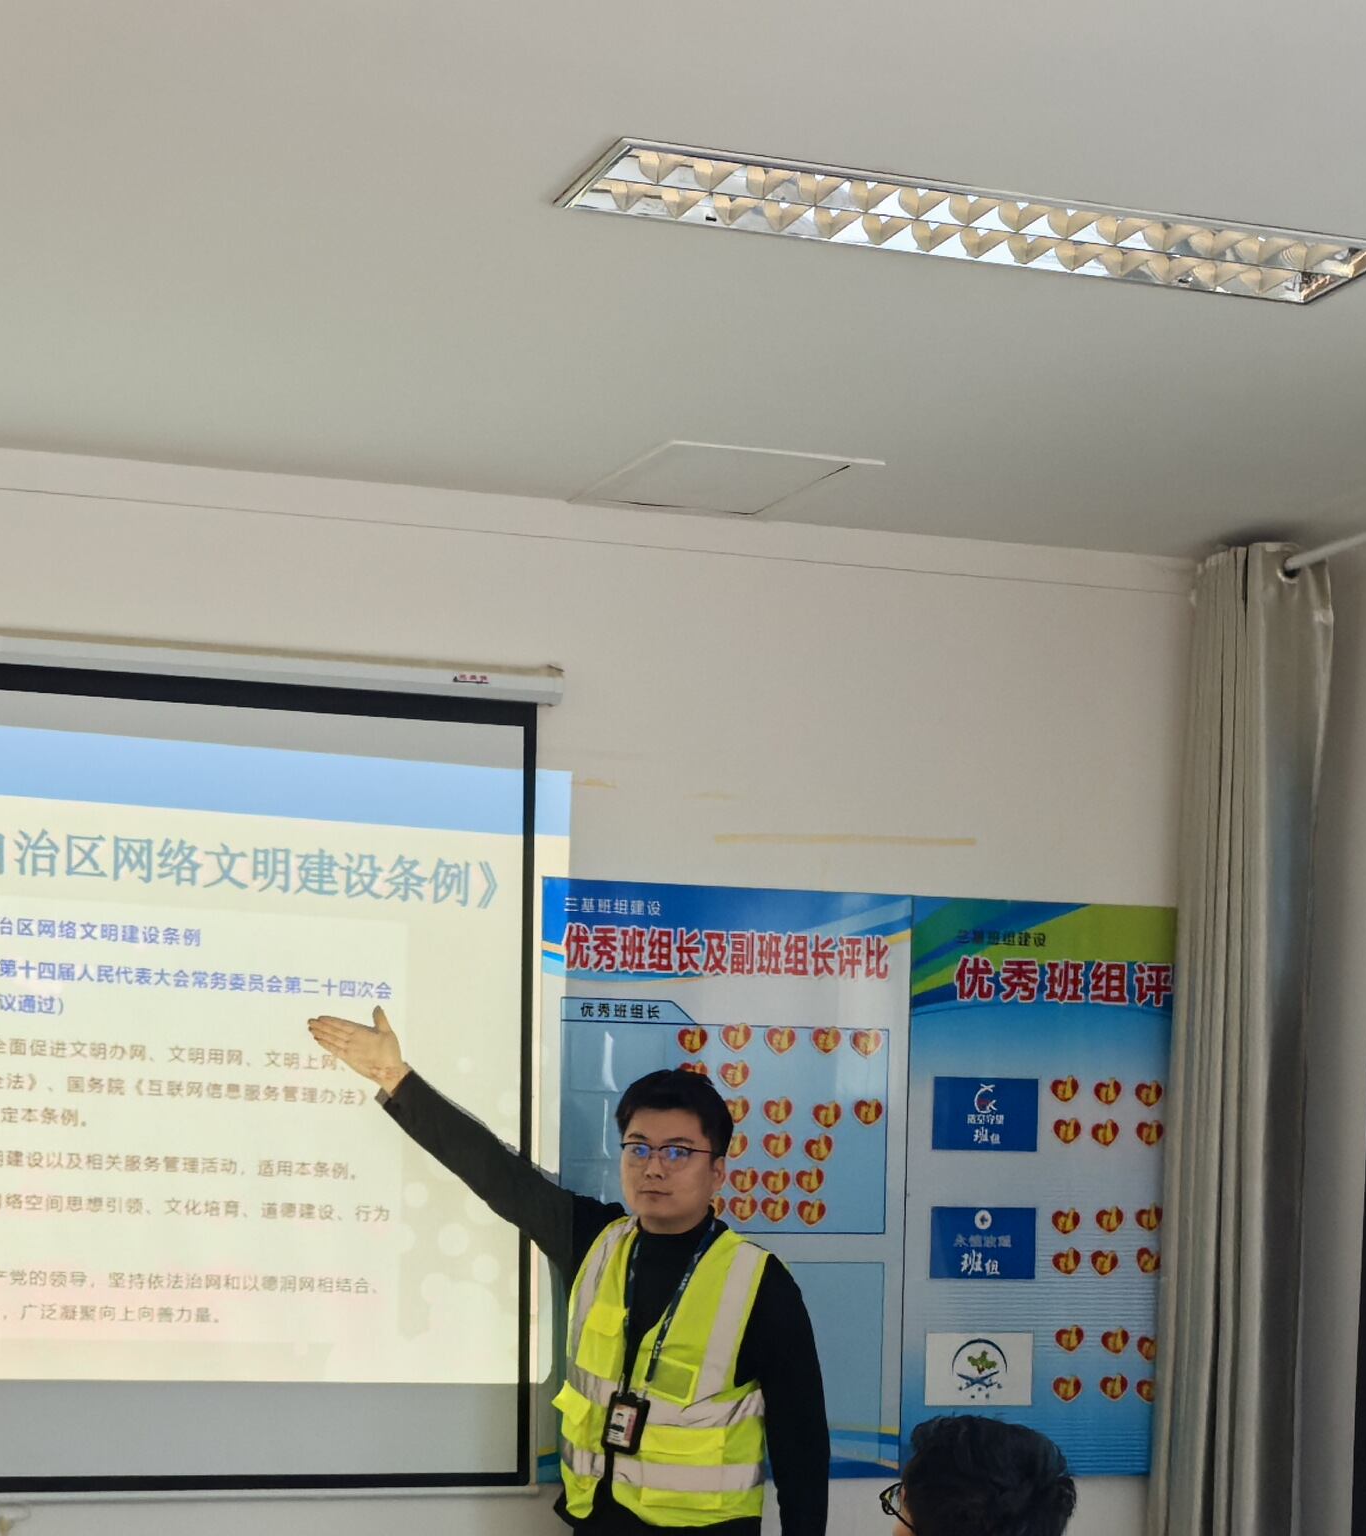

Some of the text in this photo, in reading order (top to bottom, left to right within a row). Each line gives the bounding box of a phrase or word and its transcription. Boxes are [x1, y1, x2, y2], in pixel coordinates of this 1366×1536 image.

[563, 922, 891, 981] 优秀班组长及副班组长评比
[955, 954, 1174, 1007] 优秀班组评
[580, 1002, 661, 1020] 优秀班组长
